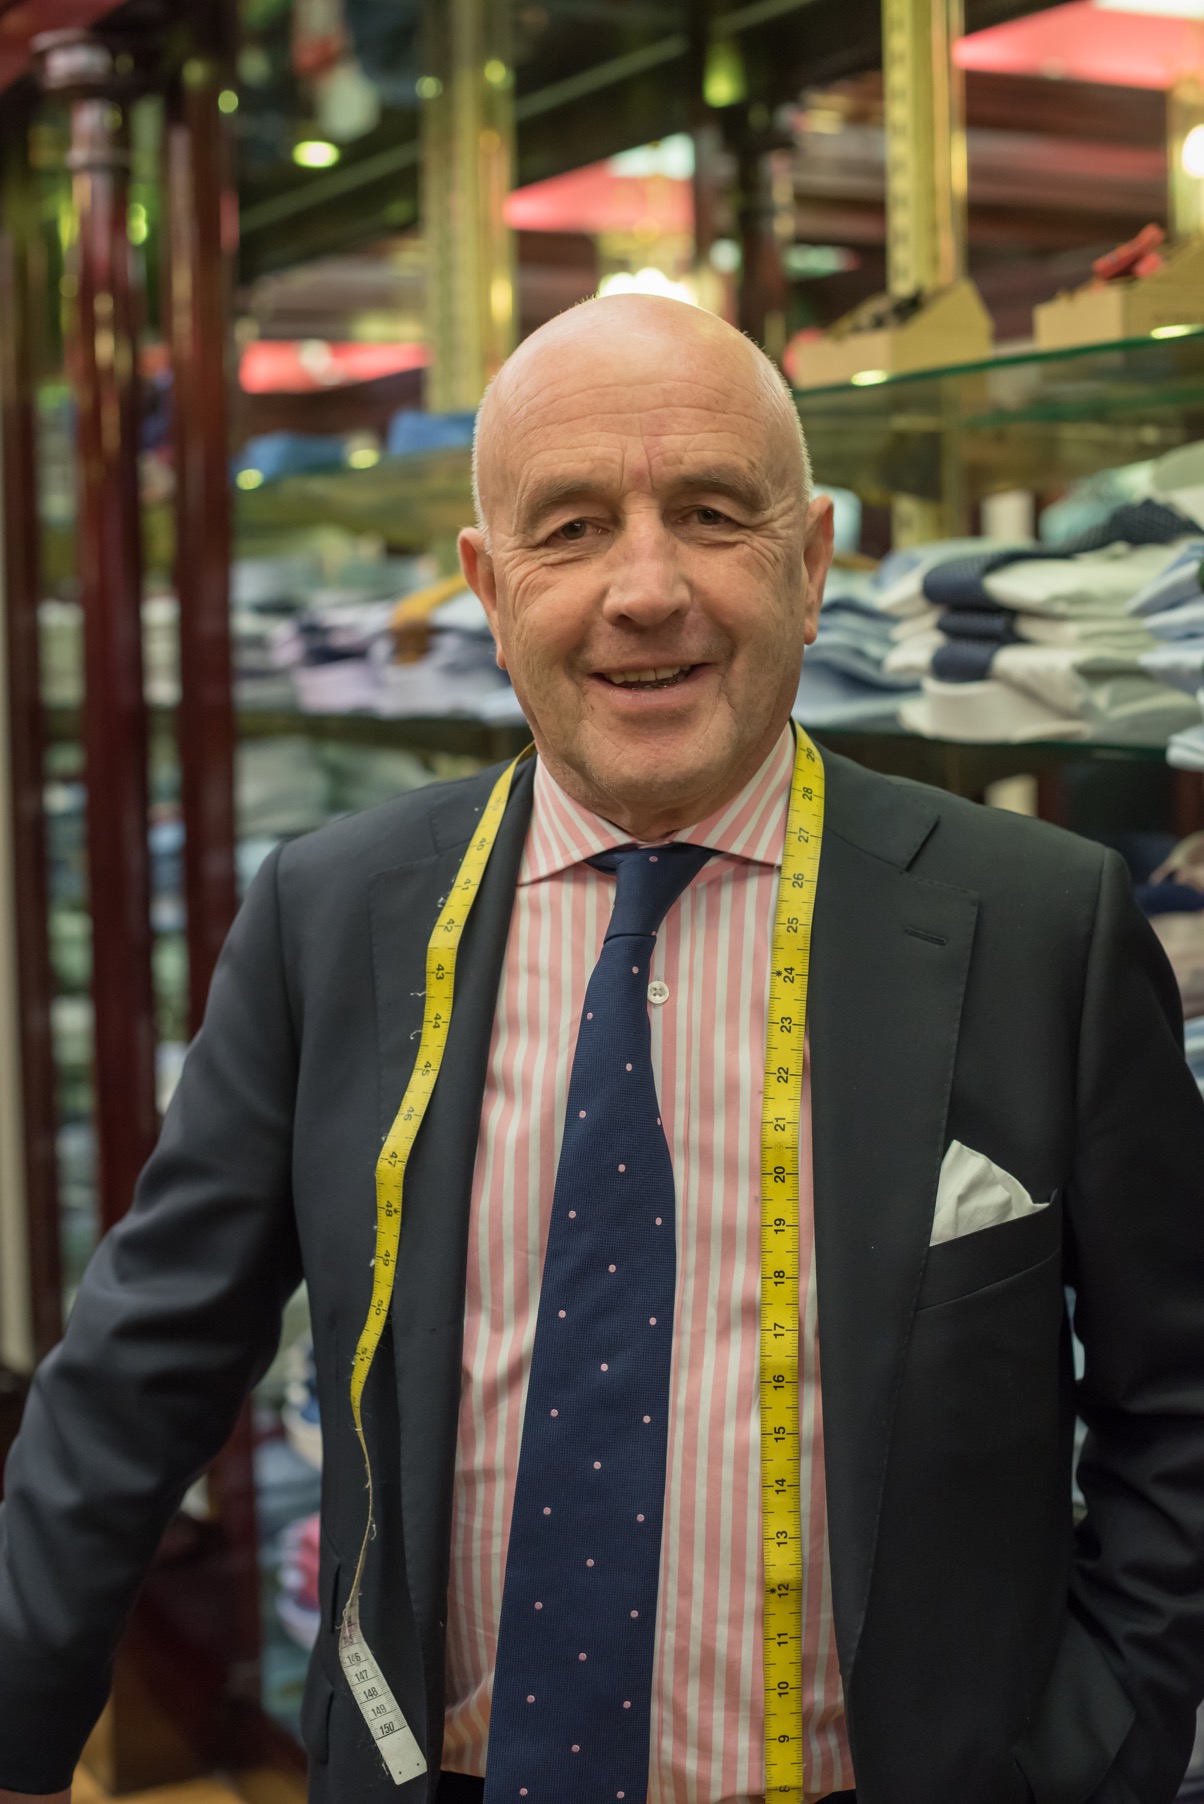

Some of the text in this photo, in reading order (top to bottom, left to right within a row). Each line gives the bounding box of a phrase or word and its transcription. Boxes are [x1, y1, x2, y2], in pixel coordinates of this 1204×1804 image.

[806, 747, 815, 762] 29
[802, 787, 813, 801] 28
[798, 827, 810, 843] 27
[461, 878, 472, 891] 41
[792, 873, 804, 888] 26
[443, 918, 455, 933] 42
[786, 917, 799, 933] 25
[435, 964, 445, 980] 43
[783, 967, 795, 984] 24
[432, 1013, 442, 1029] 44
[780, 1016, 792, 1033] 23
[421, 1061, 432, 1077] 45
[777, 1067, 789, 1084] 22
[403, 1106, 415, 1121] 46
[774, 1117, 786, 1132] 21
[388, 1151, 398, 1168] 47
[774, 1166, 786, 1183] 20
[385, 1200, 393, 1217] 48
[774, 1218, 786, 1234] 19
[383, 1250, 391, 1267] 49
[773, 1270, 786, 1287] 18
[375, 1299, 384, 1316] 50
[773, 1322, 785, 1339] 17
[773, 1374, 785, 1391] 16
[774, 1426, 786, 1443] 15
[775, 1478, 787, 1495] 14
[776, 1530, 788, 1547] 13
[777, 1583, 790, 1598] 12
[777, 1632, 789, 1647] 11
[354, 1669, 369, 1682] 147
[363, 1686, 378, 1700] 148
[777, 1681, 790, 1698] 10
[371, 1703, 387, 1717] 149
[379, 1721, 395, 1736] 150
[778, 1734, 790, 1743] 9
